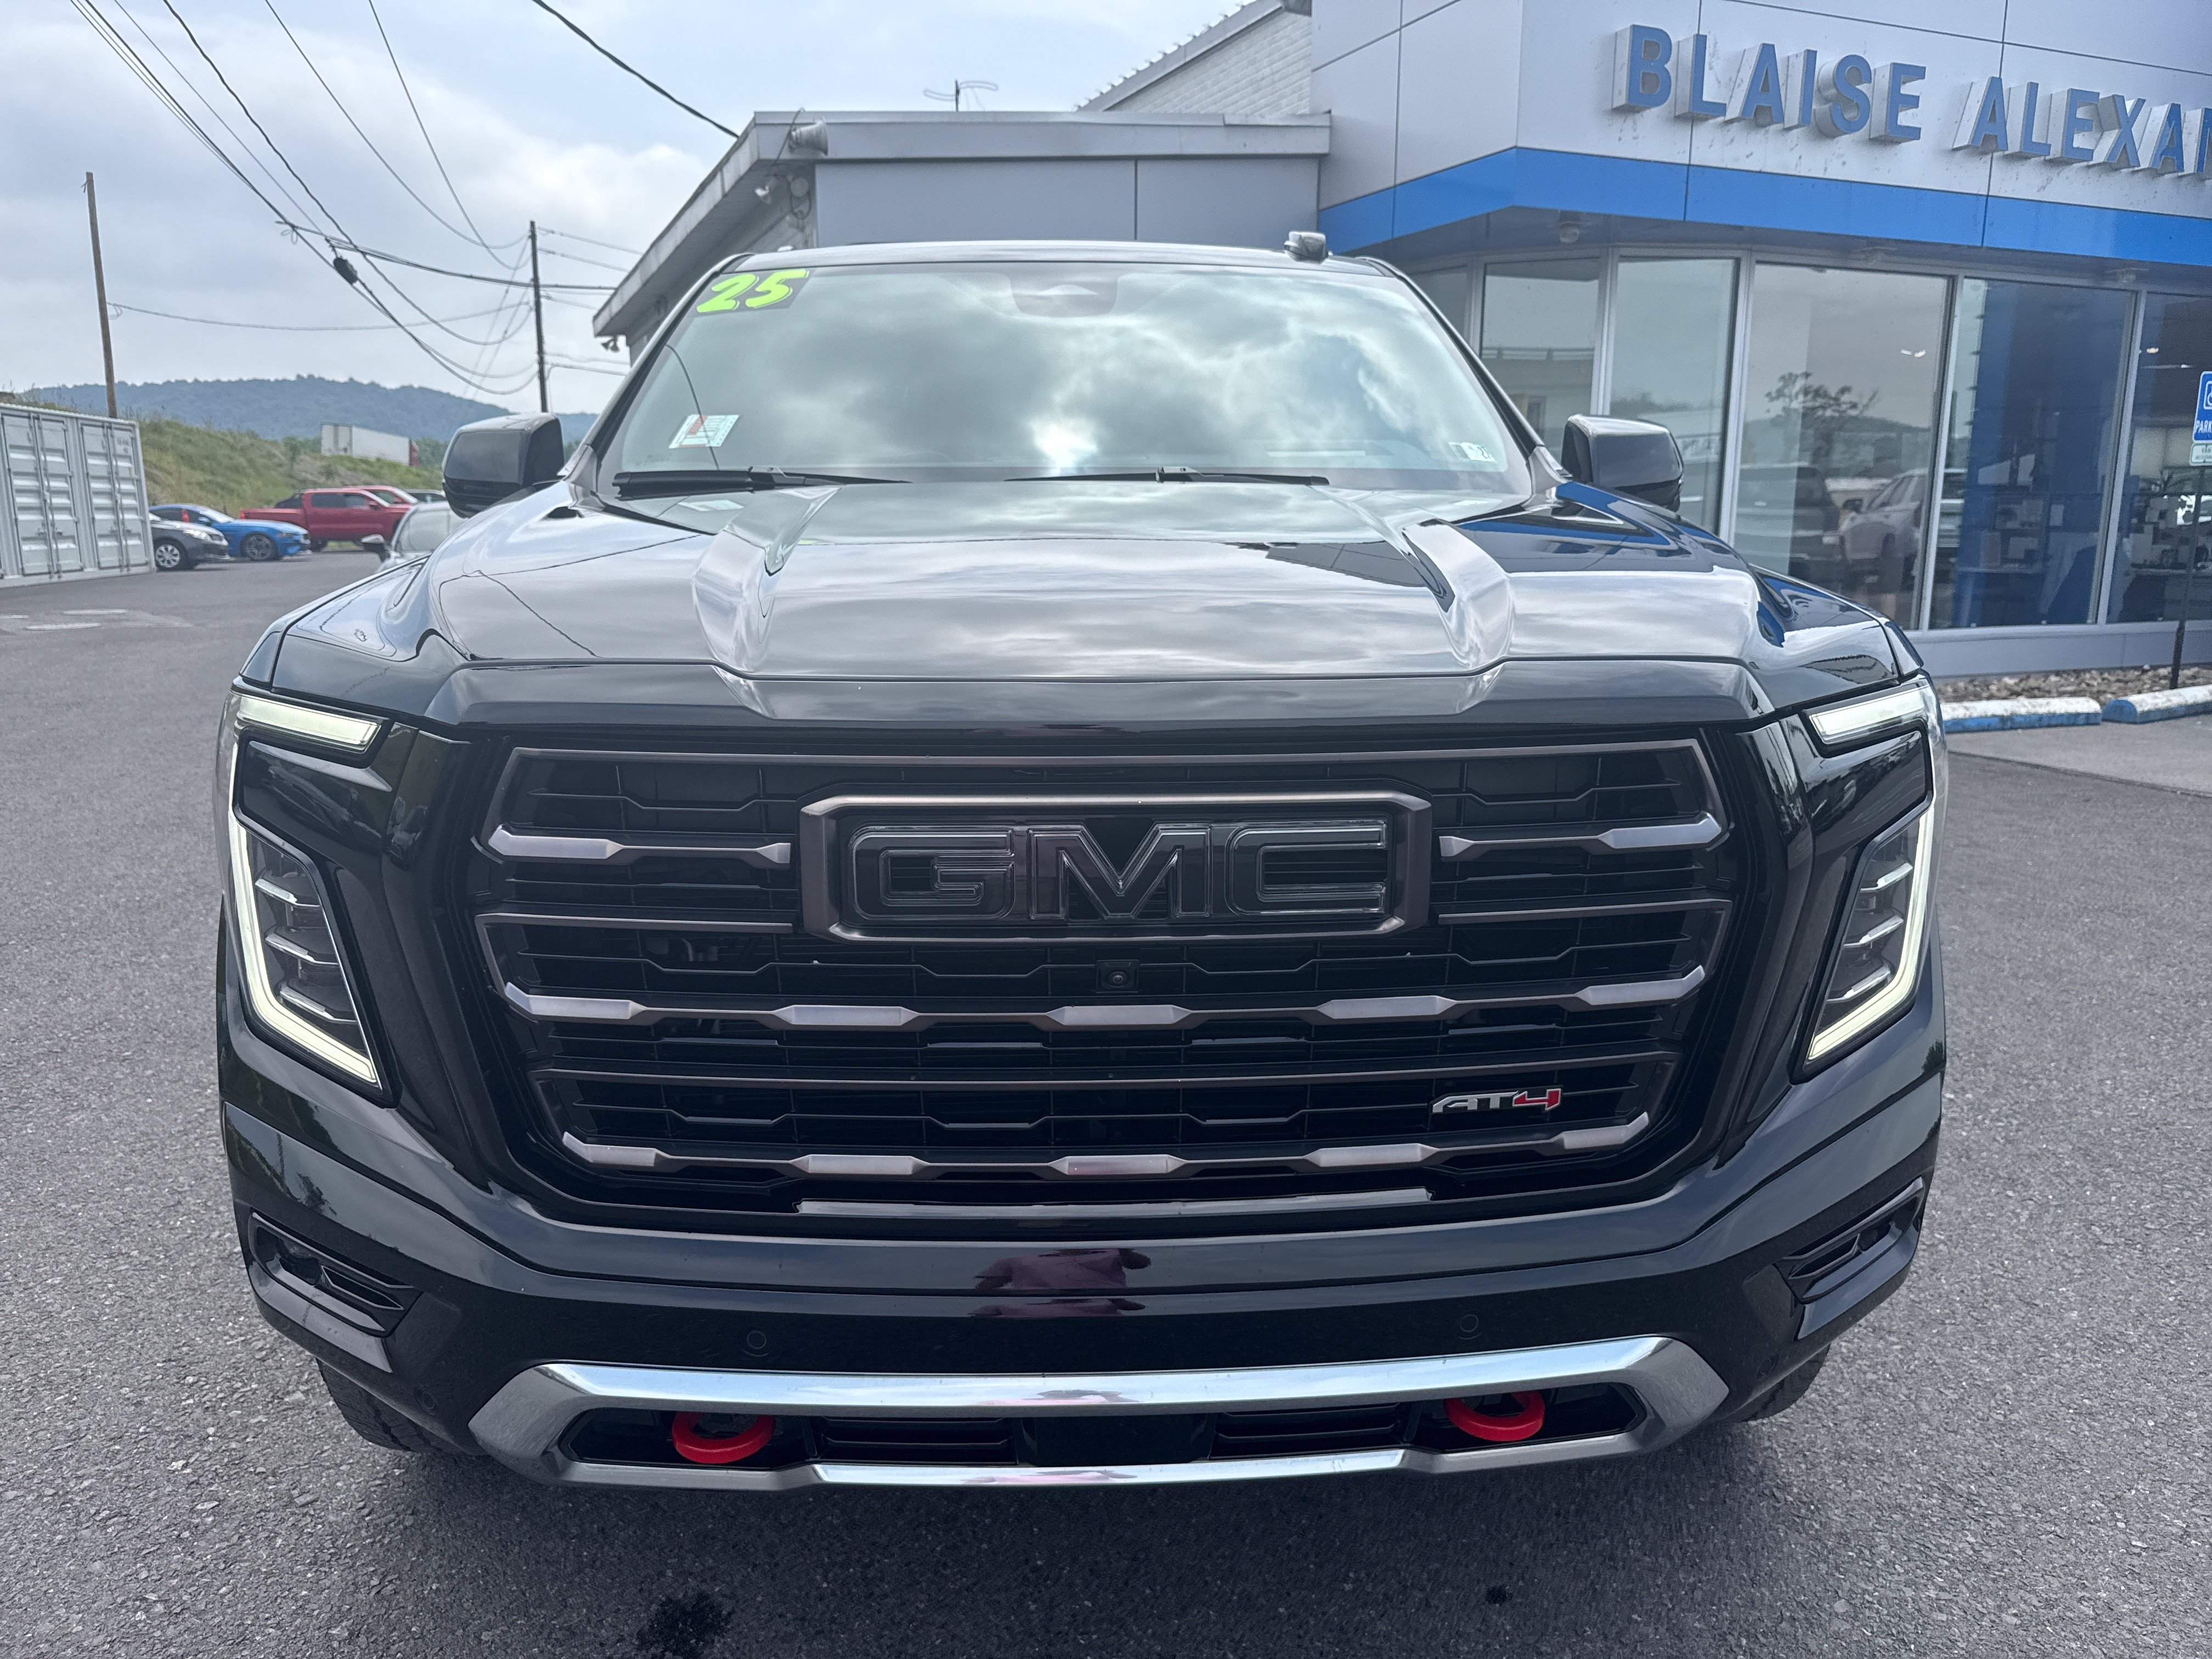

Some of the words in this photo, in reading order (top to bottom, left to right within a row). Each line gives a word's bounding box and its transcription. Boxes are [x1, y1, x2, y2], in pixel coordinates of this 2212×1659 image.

[1626, 24, 1926, 144] BLAISE
[697, 268, 809, 313] 25
[848, 820, 1388, 920] GMC
[1432, 1088, 1562, 1113] AT4
